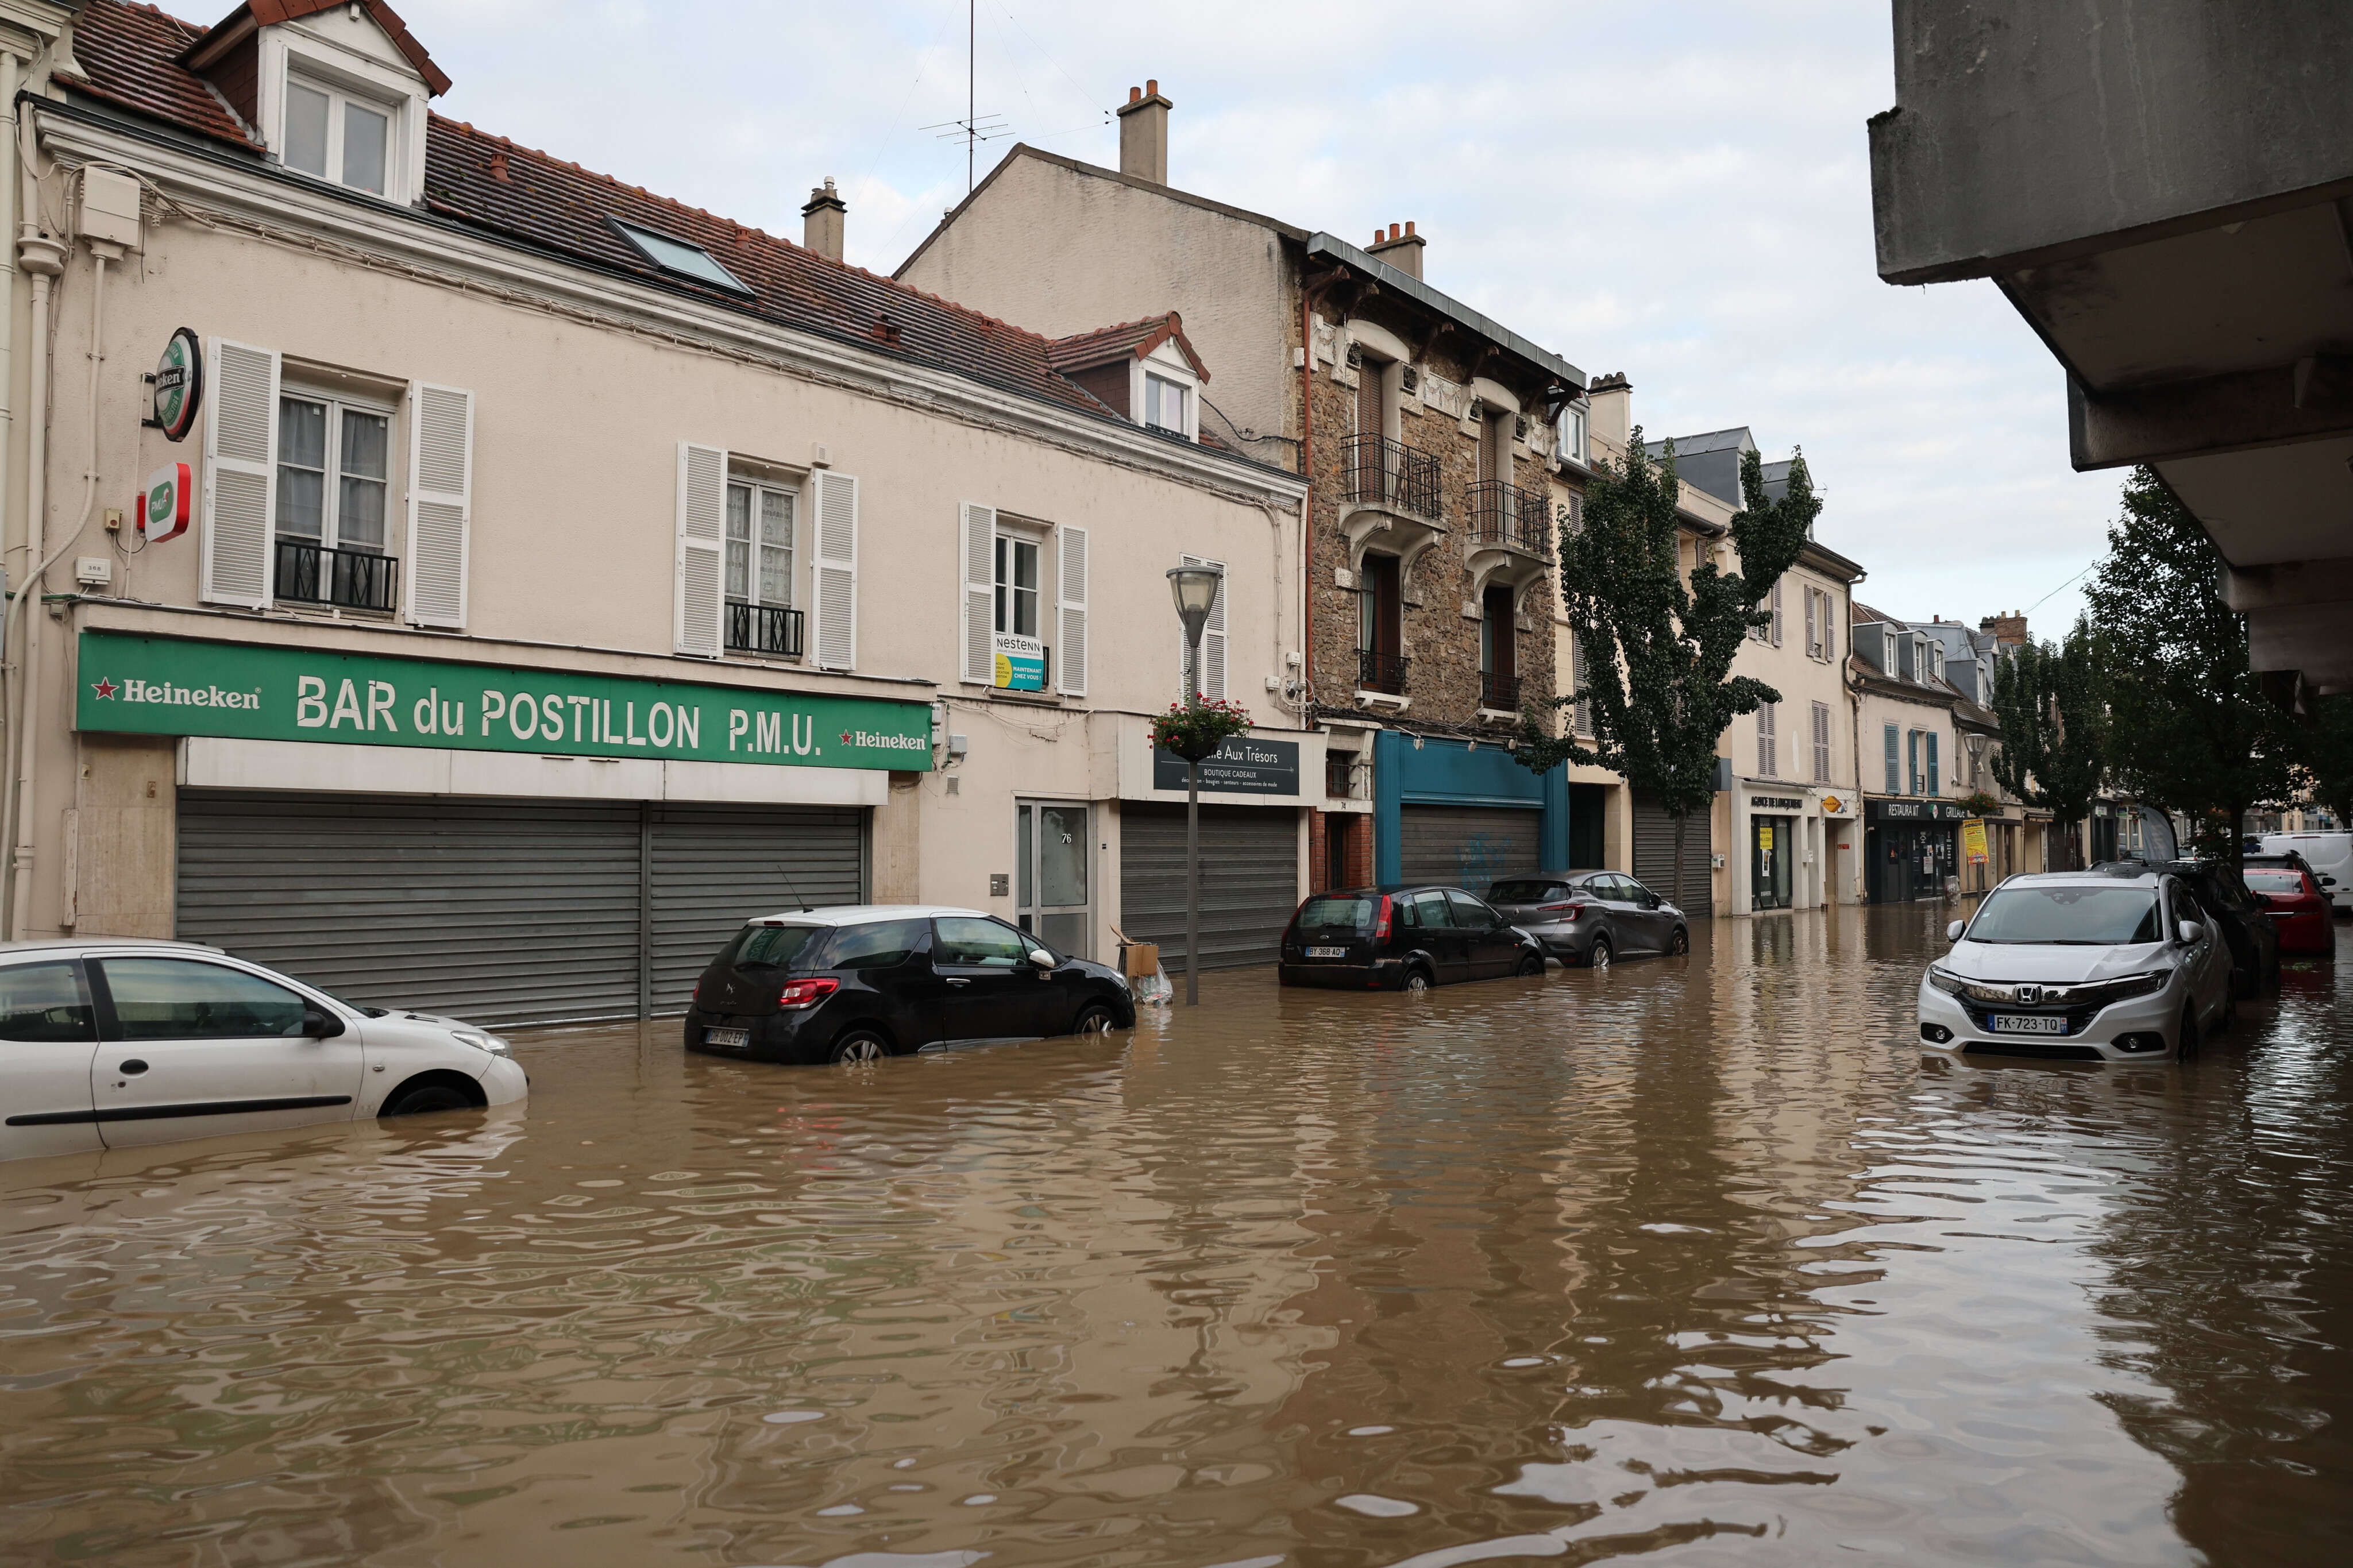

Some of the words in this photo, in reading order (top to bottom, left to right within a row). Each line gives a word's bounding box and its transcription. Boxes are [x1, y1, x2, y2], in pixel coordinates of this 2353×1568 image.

[151, 498, 165, 513] PMU
[296, 675, 398, 732] BAR
[414, 688, 464, 736] du
[481, 690, 699, 749] POSTILLON
[730, 709, 821, 756] P.M.U.
[1224, 744, 1243, 760] Aux
[1245, 746, 1278, 763] Trésors
[1204, 768, 1231, 778] BOUTIQUE
[1232, 771, 1256, 779] CADEAUX
[1888, 804, 1919, 817] RESTAURANT
[1062, 833, 1071, 844] 76
[1997, 1017, 2058, 1030] FK-723-TQ
[710, 1030, 743, 1044] DH-002-EP
